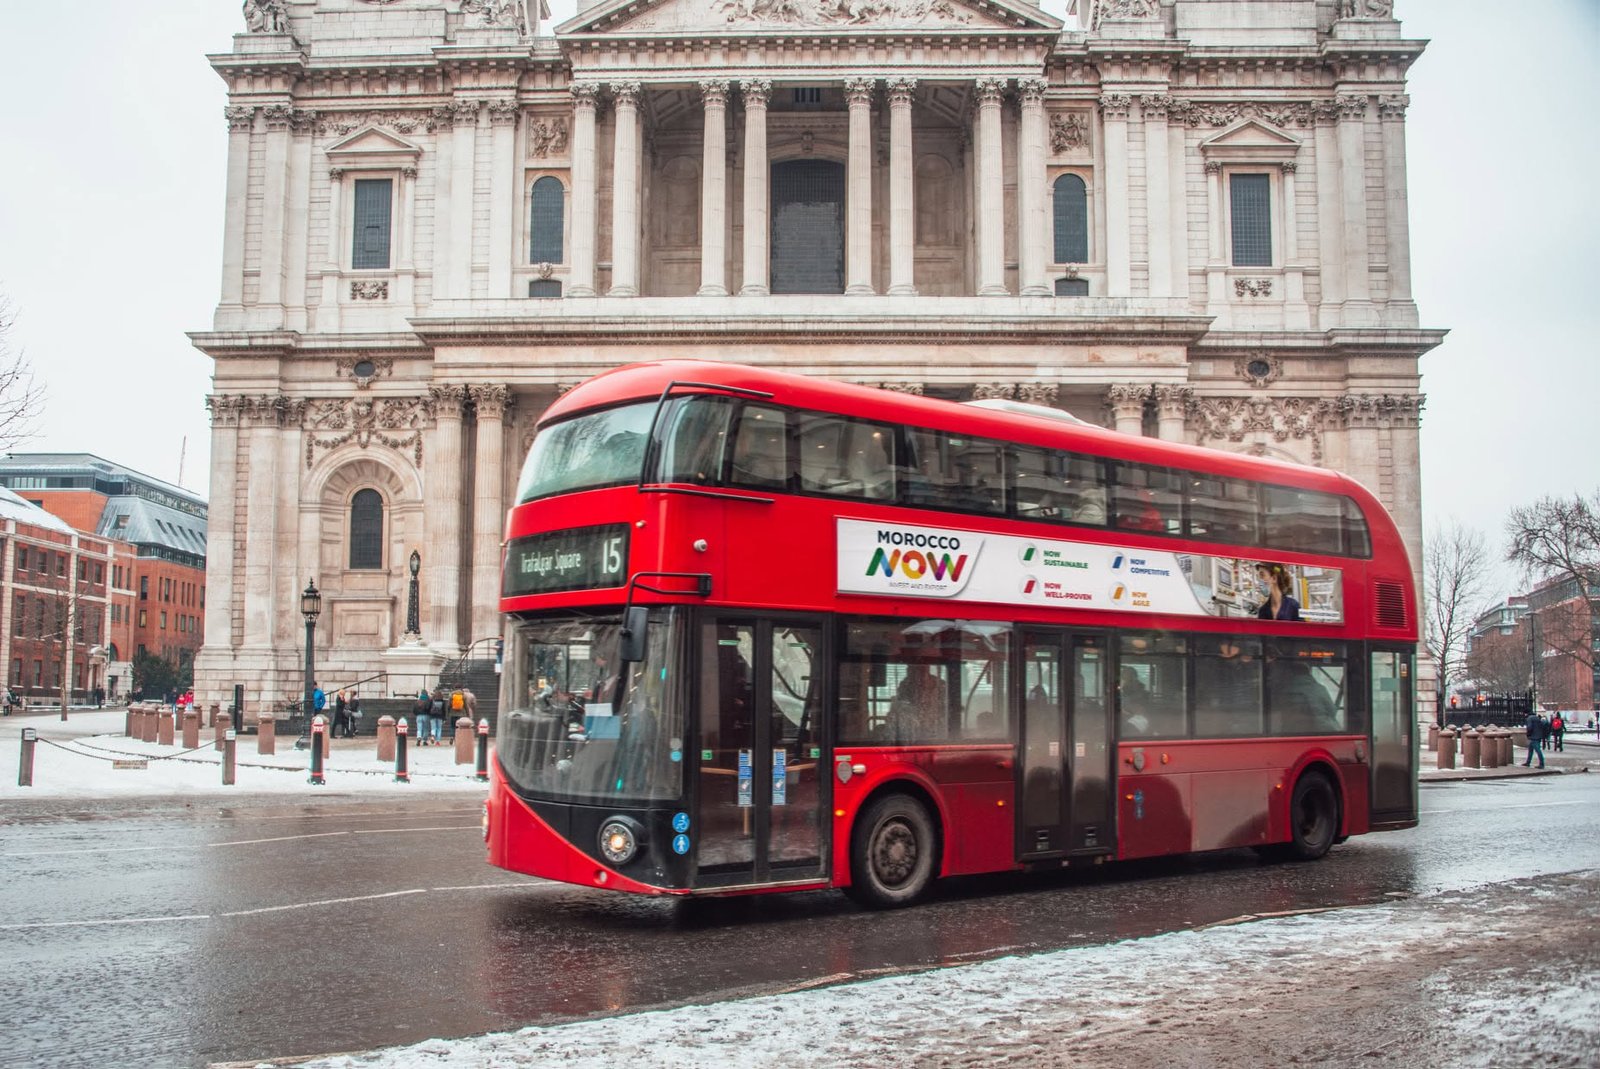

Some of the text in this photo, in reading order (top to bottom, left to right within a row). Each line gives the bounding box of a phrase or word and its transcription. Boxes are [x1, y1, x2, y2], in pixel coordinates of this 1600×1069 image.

[877, 530, 960, 550] MOROCCO
[521, 537, 621, 576] Trafalgar Square 15
[1044, 559, 1088, 569] SUSTAINABLE
[865, 547, 968, 582] NOW
[1130, 567, 1170, 576] COMPETITIVE
[1044, 591, 1093, 601] WELL-PROVEN
